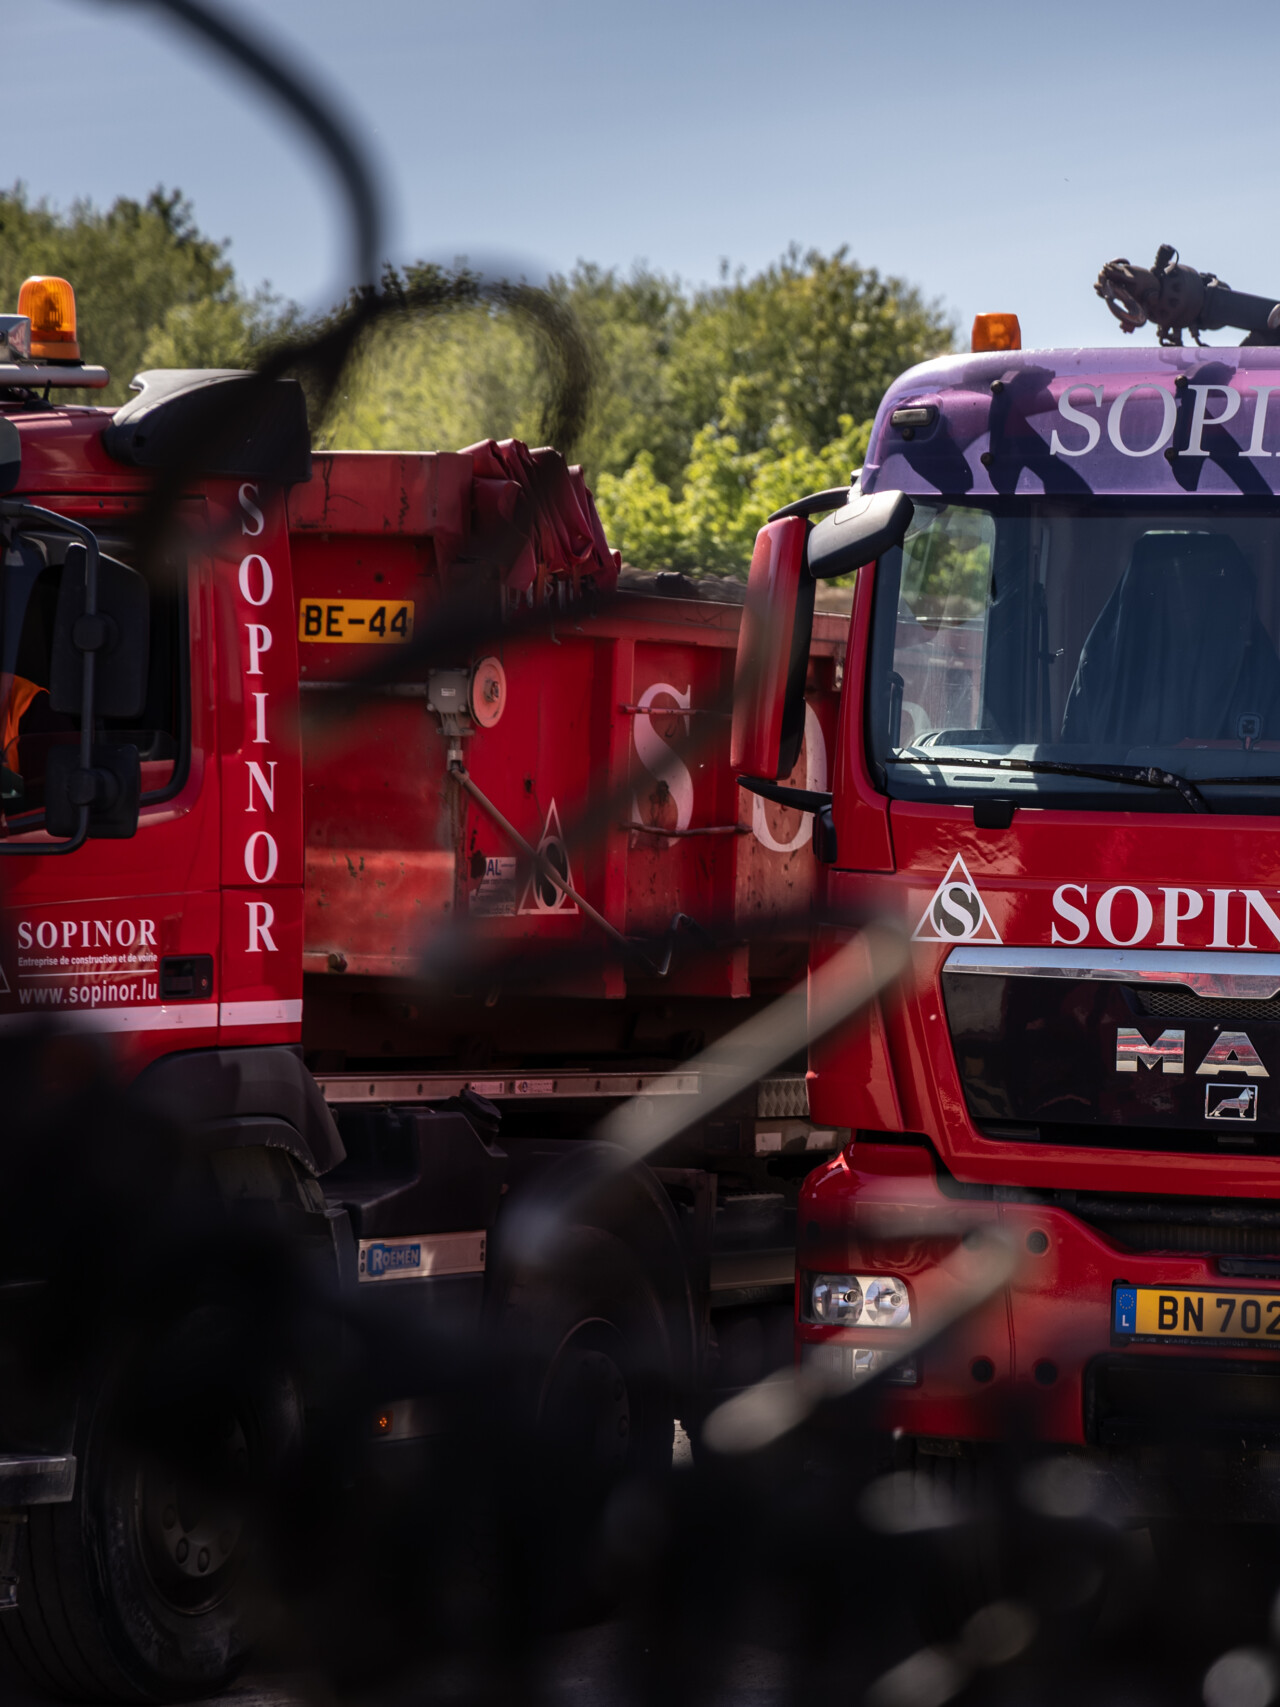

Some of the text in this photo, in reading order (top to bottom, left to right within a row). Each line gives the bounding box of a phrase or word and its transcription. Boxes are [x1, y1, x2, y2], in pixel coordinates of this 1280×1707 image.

[305, 605, 409, 637] BE-44
[238, 483, 279, 952] SOPINOR
[940, 883, 976, 938] S
[18, 919, 158, 950] SOPINOR
[18, 951, 158, 968] Entreprise de construction et de voirie
[18, 978, 157, 1008] www.sopinor.lu
[1122, 1314, 1130, 1327] L
[1158, 1295, 1204, 1332] BN
